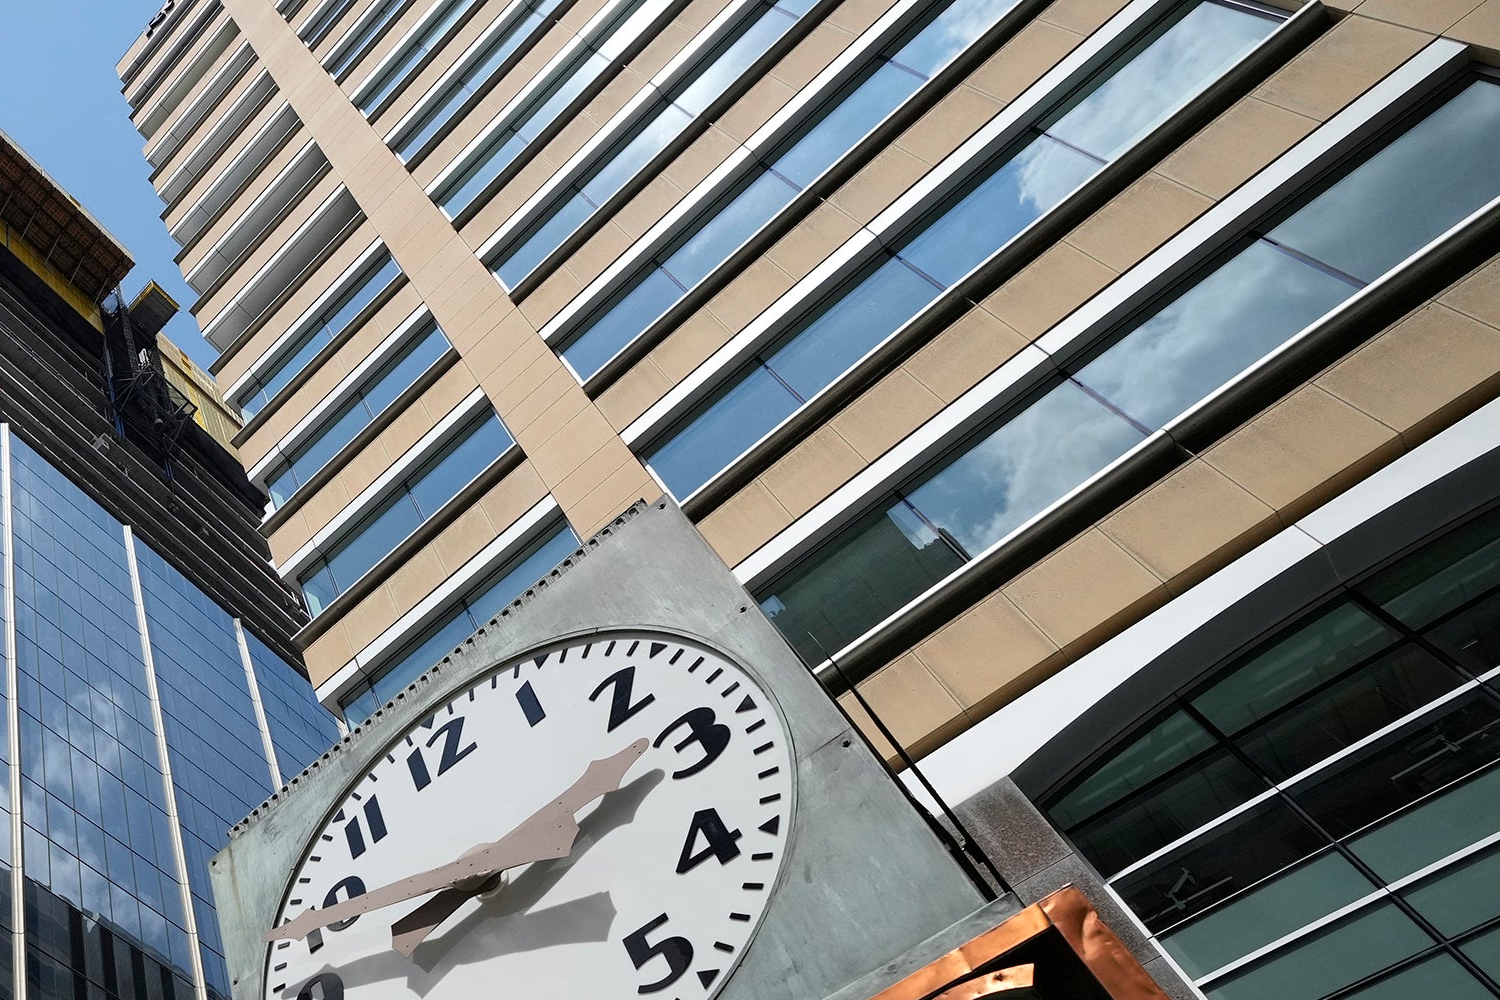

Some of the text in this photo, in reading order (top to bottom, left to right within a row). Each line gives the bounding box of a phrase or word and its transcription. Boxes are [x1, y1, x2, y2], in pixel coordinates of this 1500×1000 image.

[515, 679, 547, 728] 1
[588, 665, 656, 733] 2
[406, 716, 478, 792] 12
[652, 706, 732, 780] 3
[344, 793, 388, 860] 11
[675, 807, 743, 875] 4
[622, 912, 695, 995] 5
